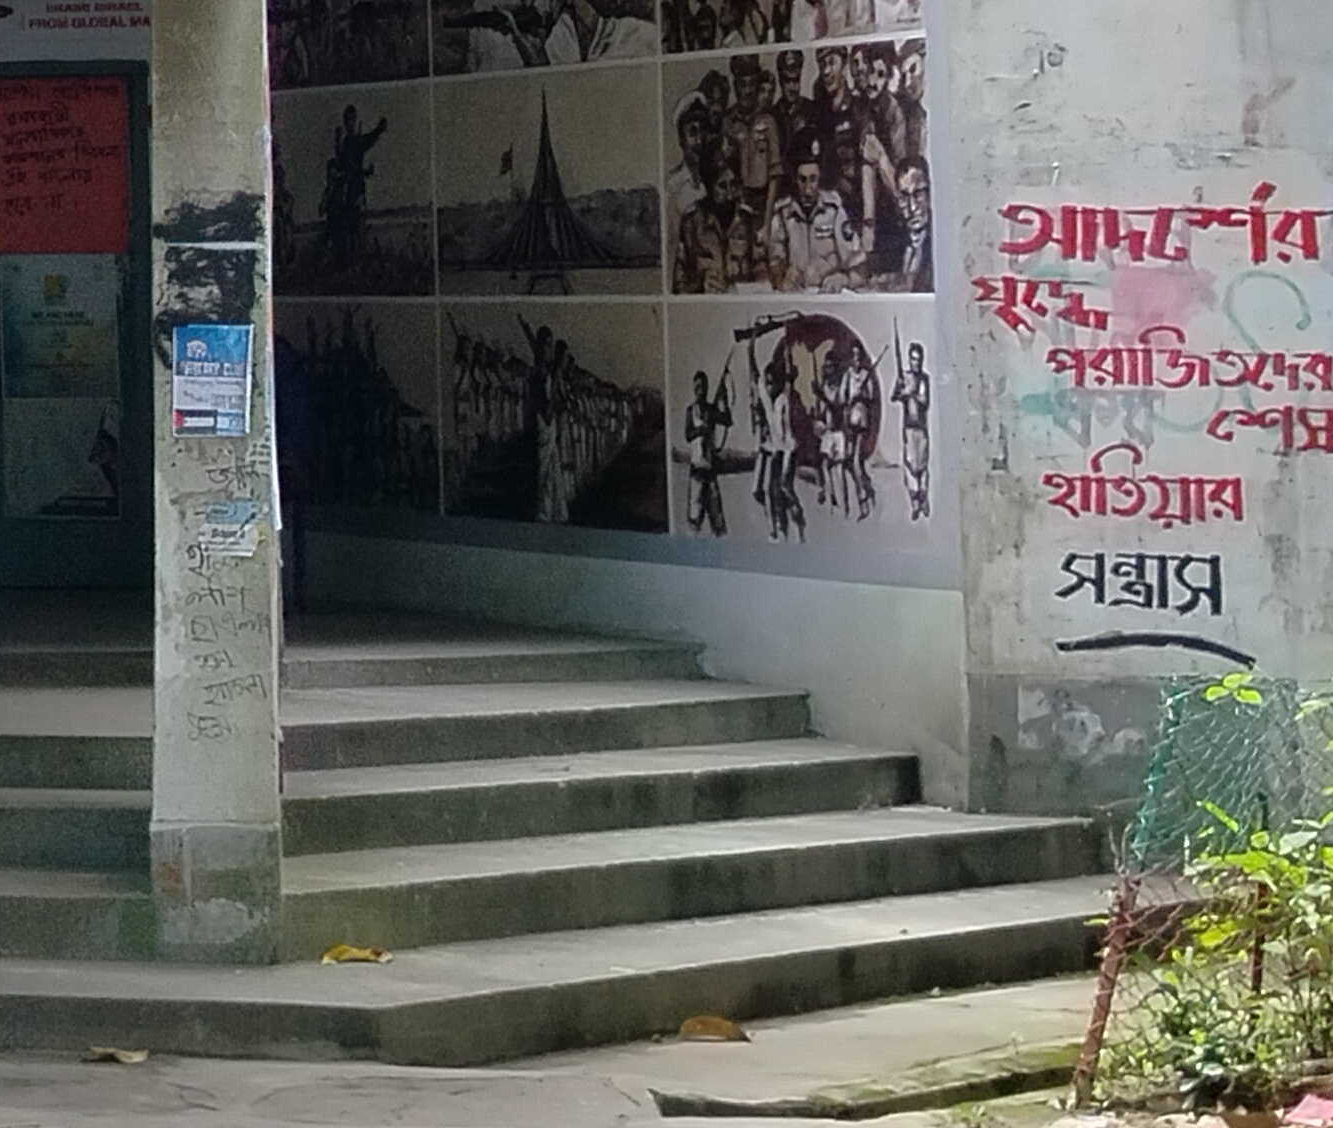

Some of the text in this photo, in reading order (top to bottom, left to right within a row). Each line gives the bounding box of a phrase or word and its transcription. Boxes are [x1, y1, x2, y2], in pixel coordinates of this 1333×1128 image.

[998, 180, 1331, 265] আদর্শের
[971, 275, 1109, 334] যুদ্ধে
[1043, 443, 1243, 530] হাতিয়ার
[1055, 552, 1223, 616] সন্ত্রাস
